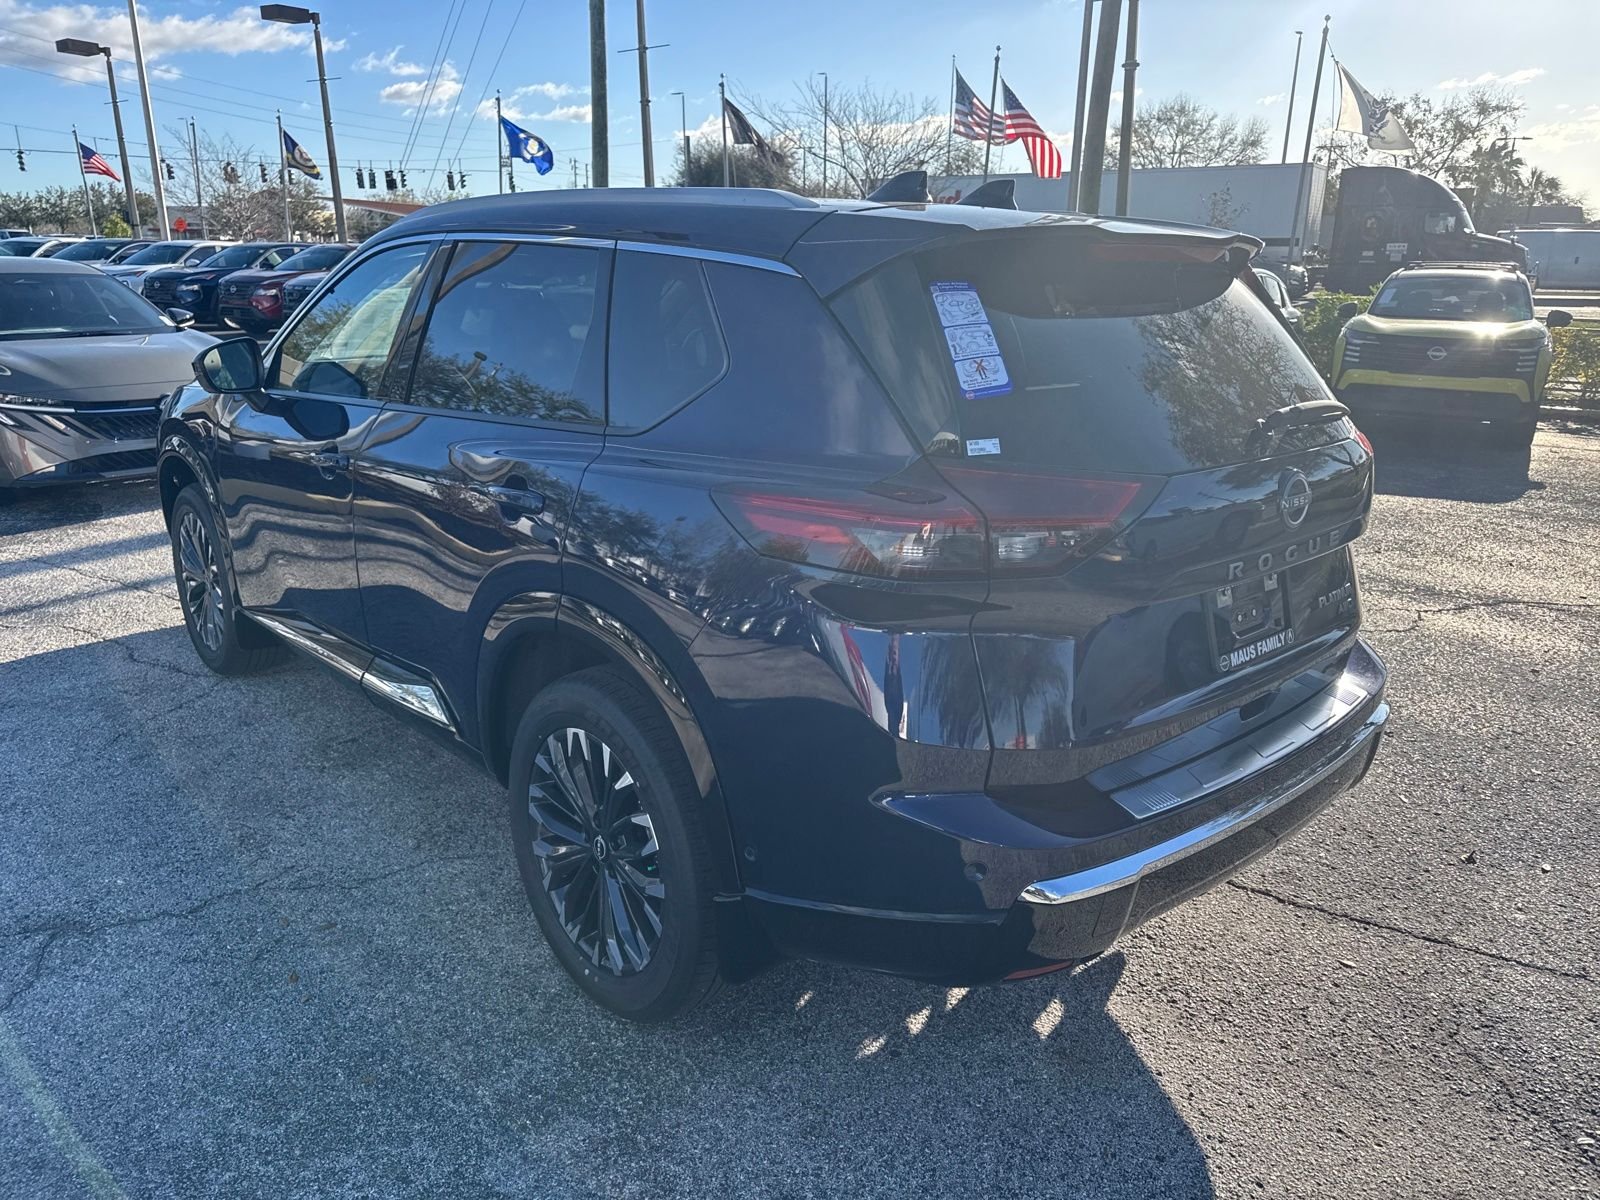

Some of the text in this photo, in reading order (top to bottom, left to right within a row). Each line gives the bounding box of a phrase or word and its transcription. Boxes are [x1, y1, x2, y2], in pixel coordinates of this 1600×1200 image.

[1281, 492, 1311, 509] NISS
[1228, 530, 1341, 580] ROGUE
[1230, 632, 1286, 667] MAUS FAMILY
